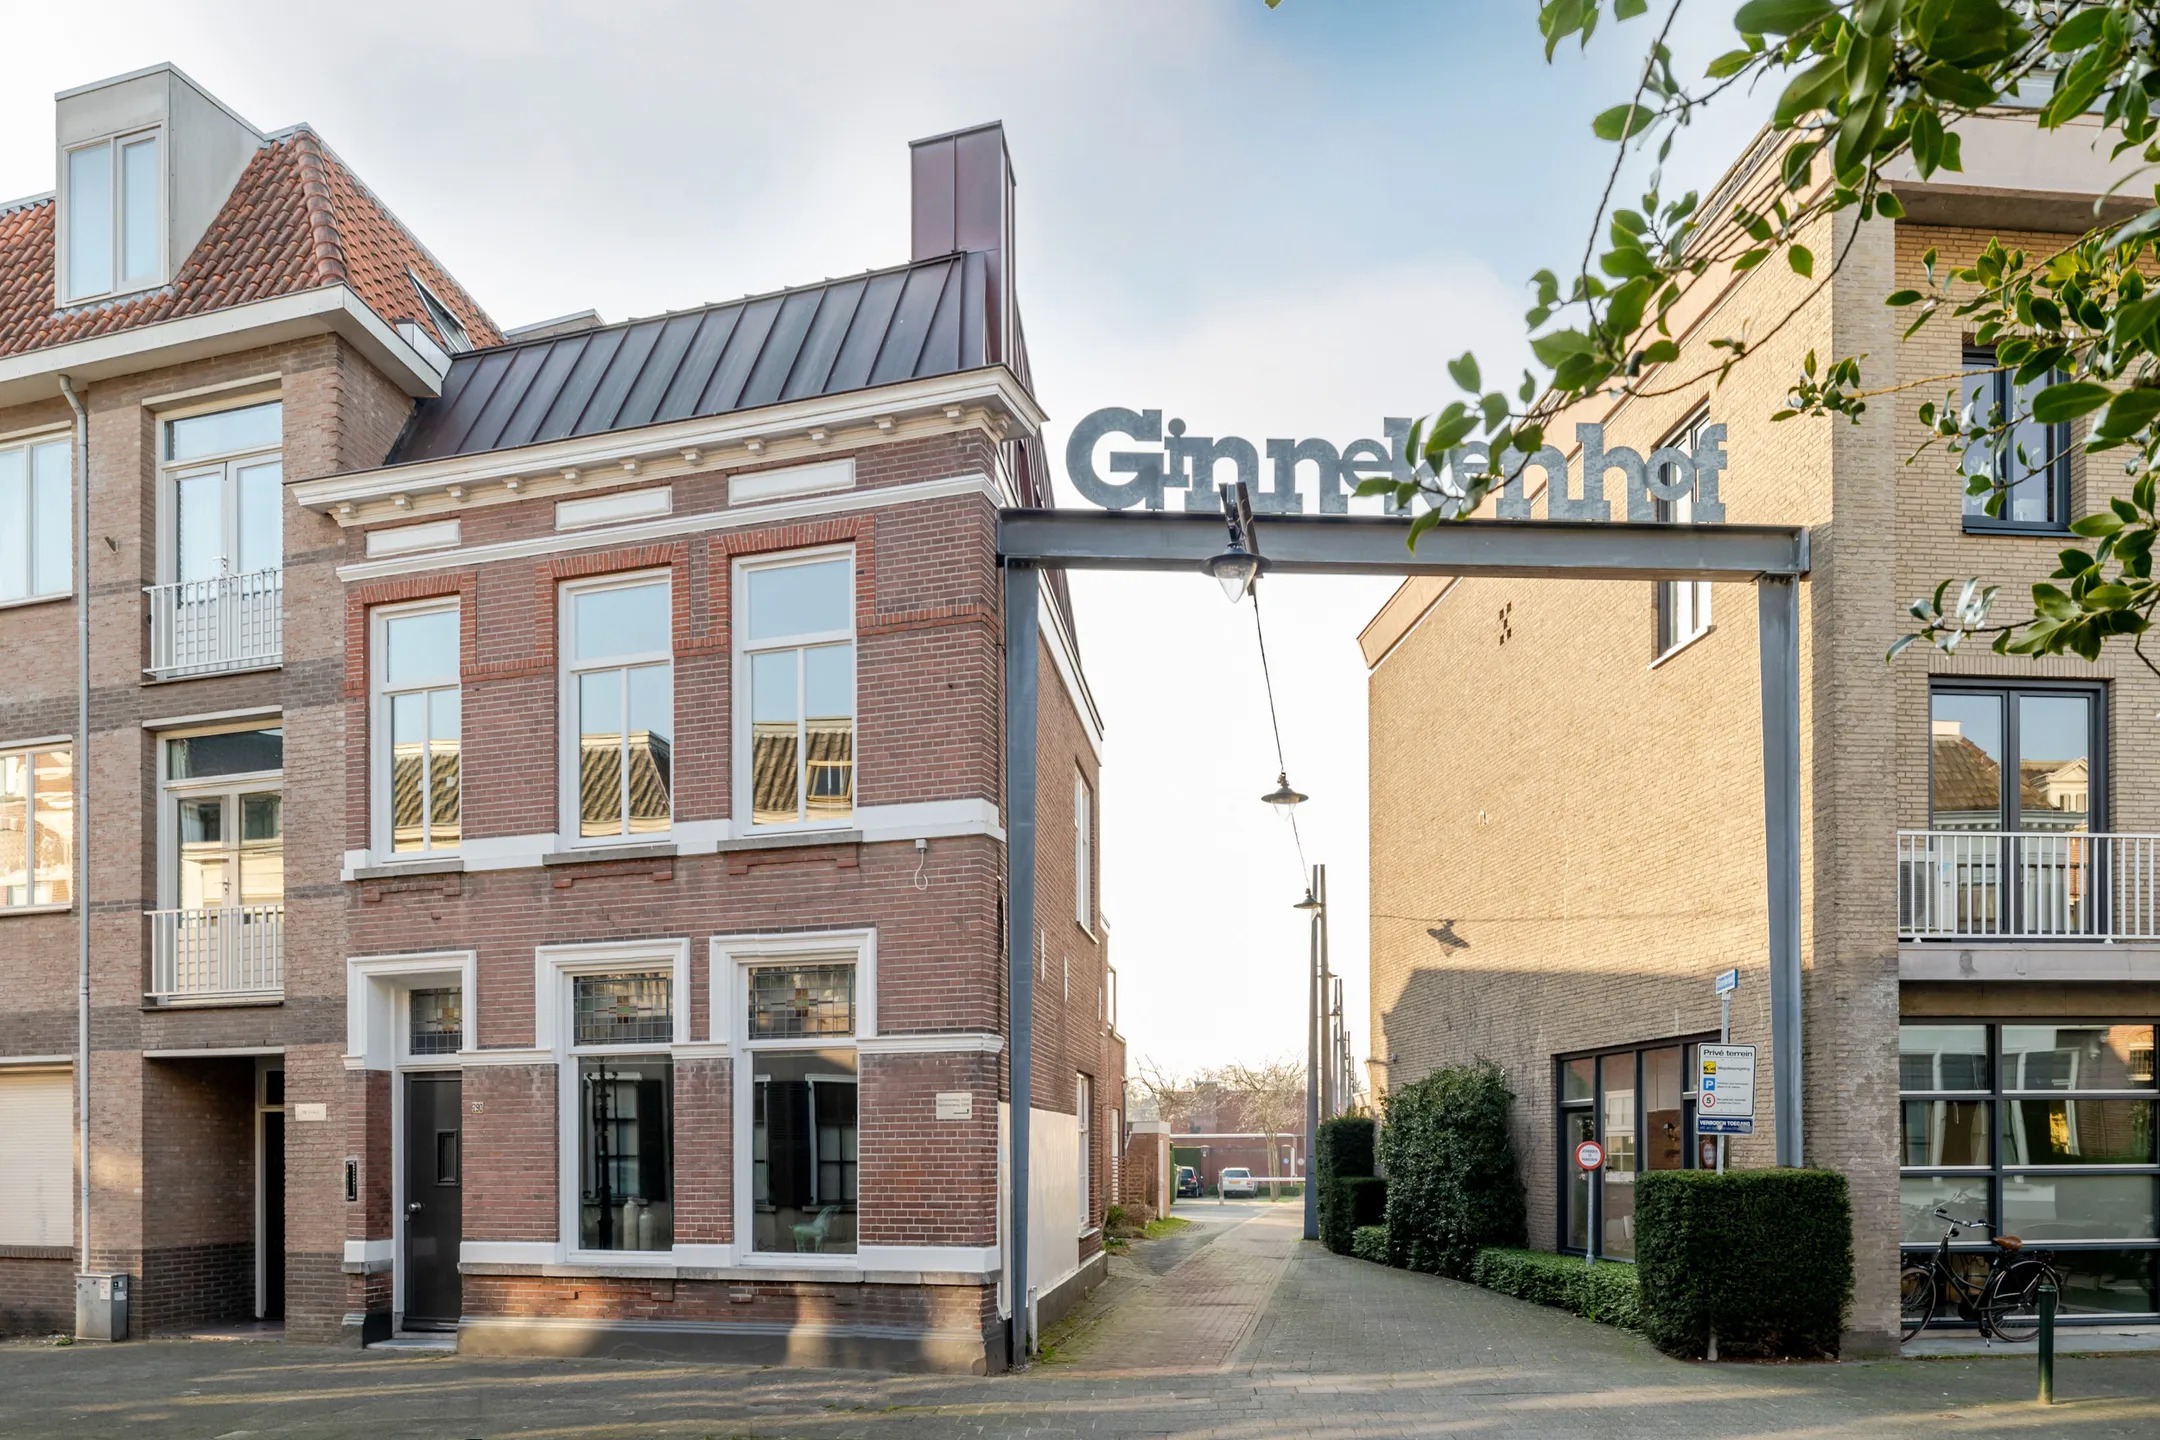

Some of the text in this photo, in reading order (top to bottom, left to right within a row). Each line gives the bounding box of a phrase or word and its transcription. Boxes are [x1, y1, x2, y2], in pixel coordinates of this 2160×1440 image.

[1065, 406, 1727, 522] Ginnekenhof
[1703, 1049, 1724, 1057] Privé
[1705, 1080, 1714, 1089] P
